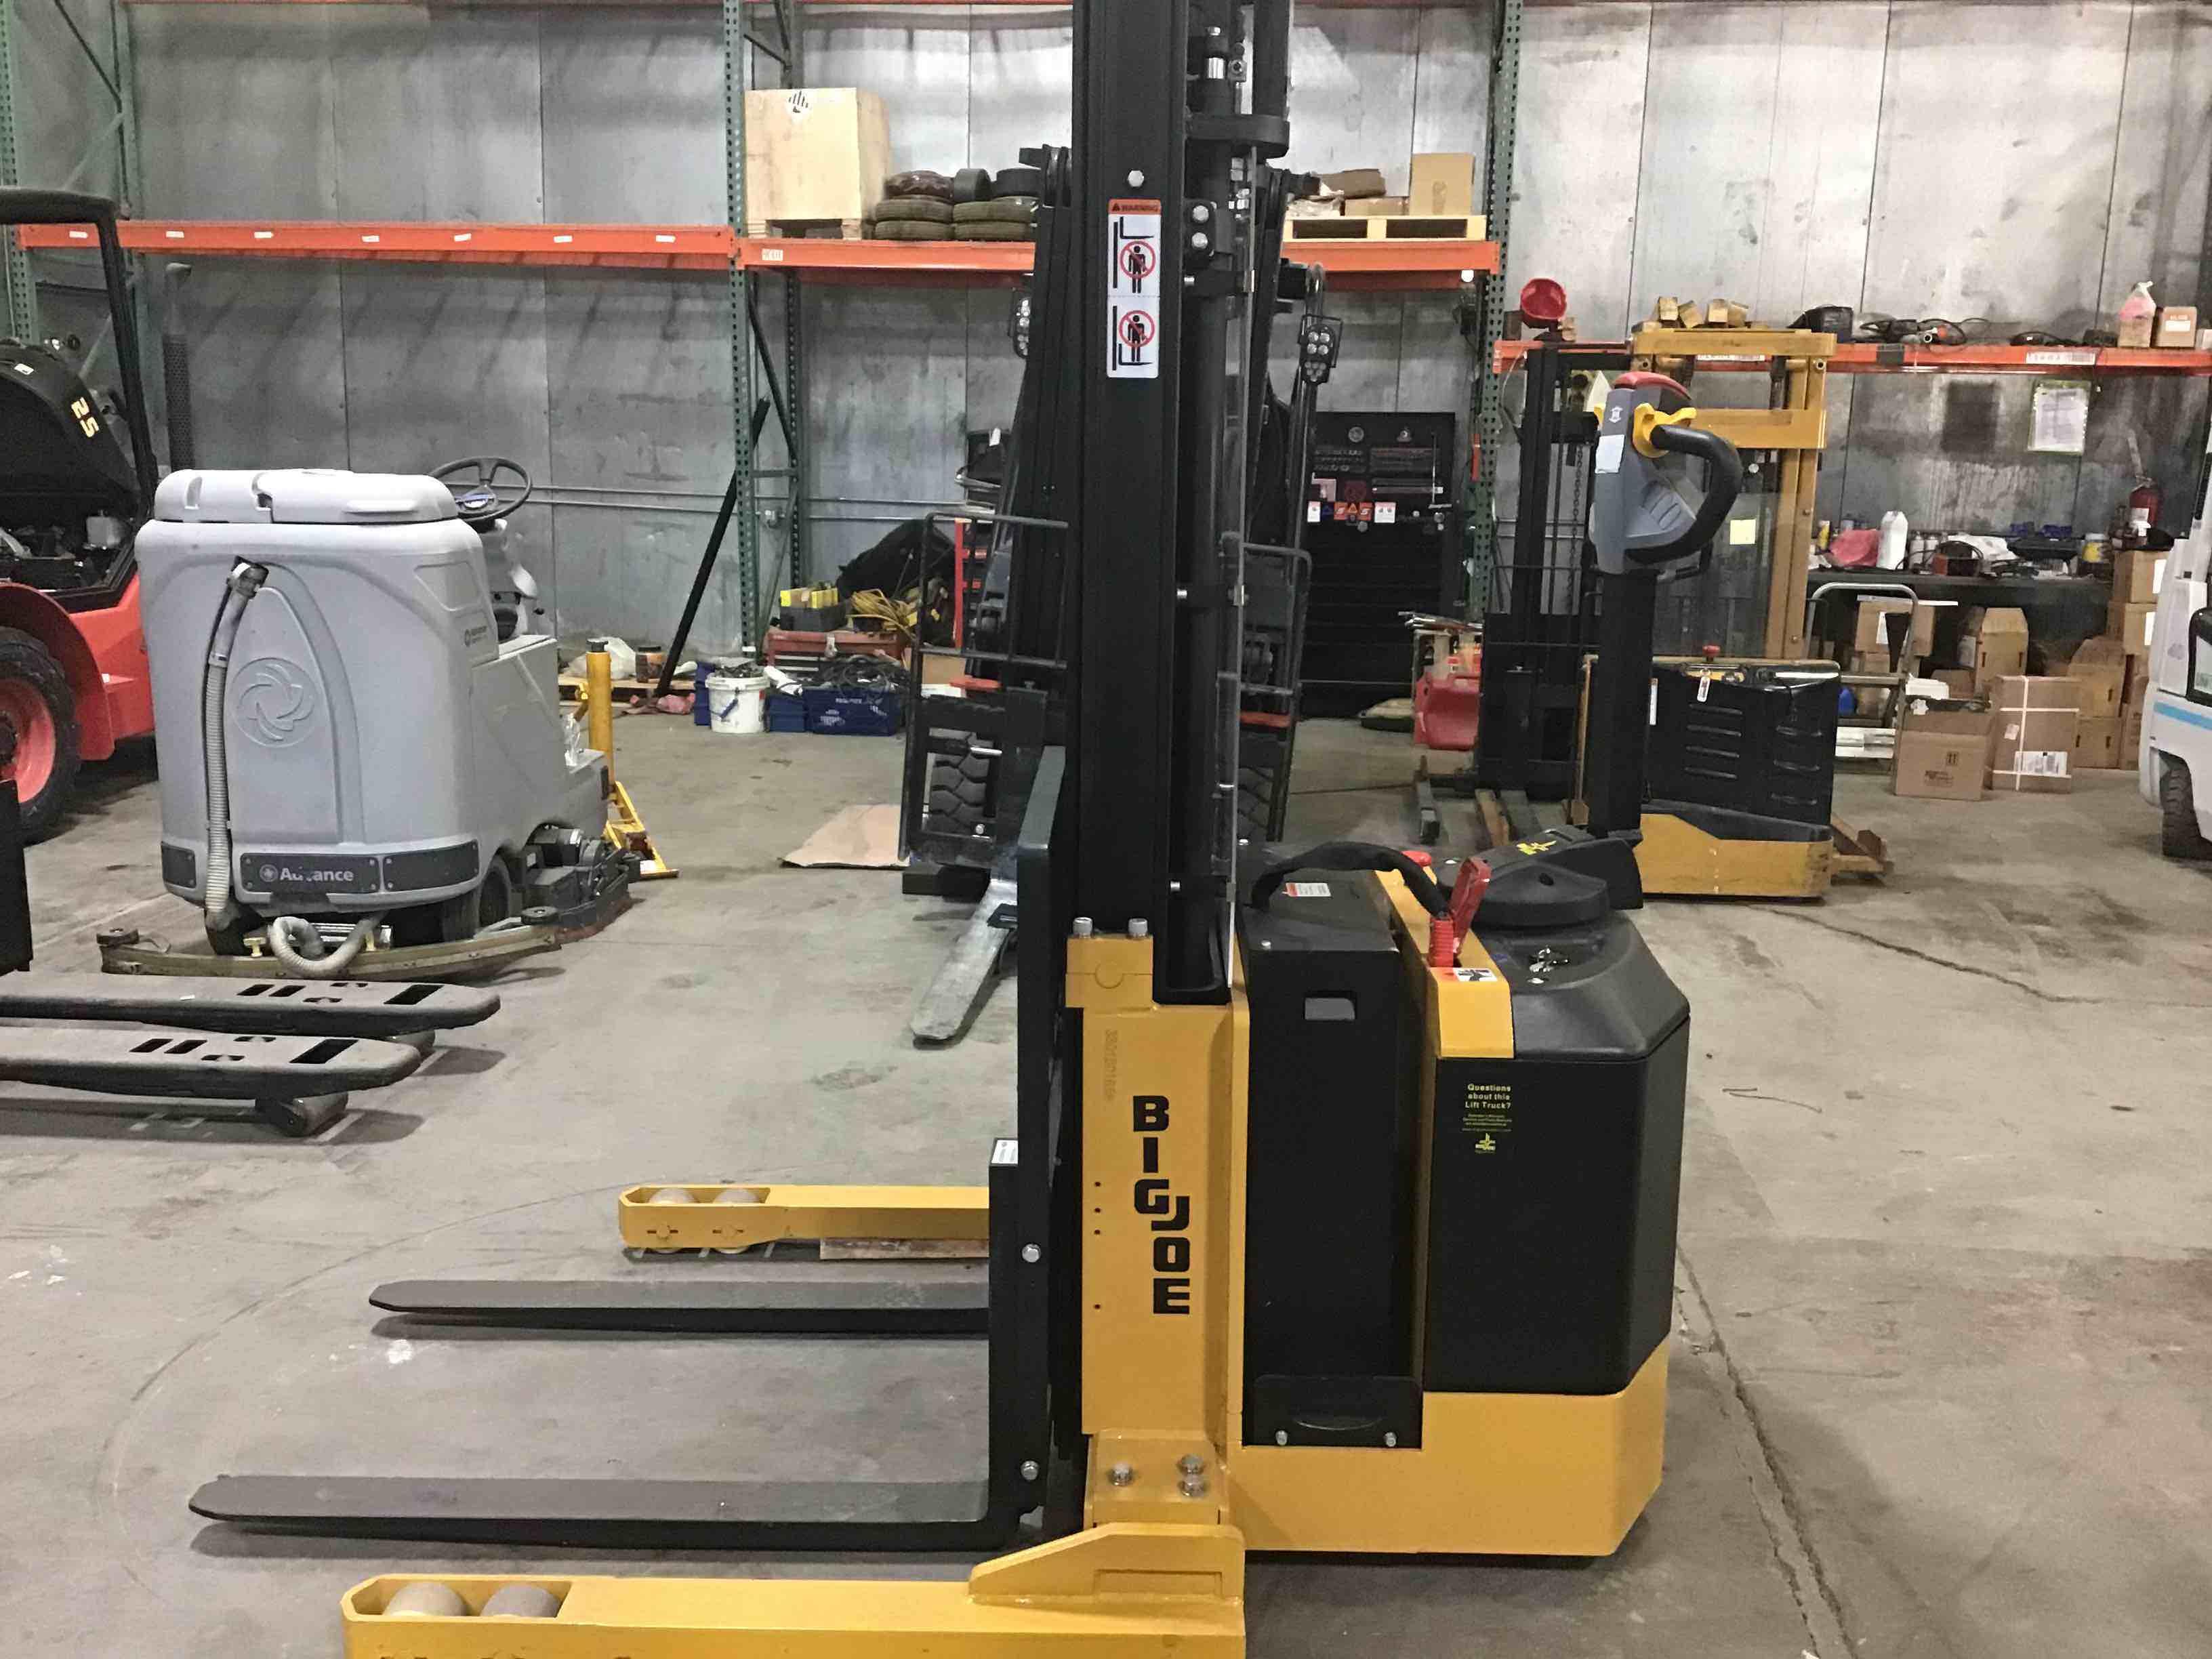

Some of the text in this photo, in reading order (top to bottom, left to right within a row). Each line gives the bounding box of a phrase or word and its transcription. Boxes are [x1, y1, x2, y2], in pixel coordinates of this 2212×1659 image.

[70, 396, 100, 438] 25
[1467, 1084, 1511, 1092] Questions
[1481, 1101, 1512, 1109] Truck?
[1132, 1095, 1170, 1214] BIG
[1151, 1195, 1190, 1315] JOE
